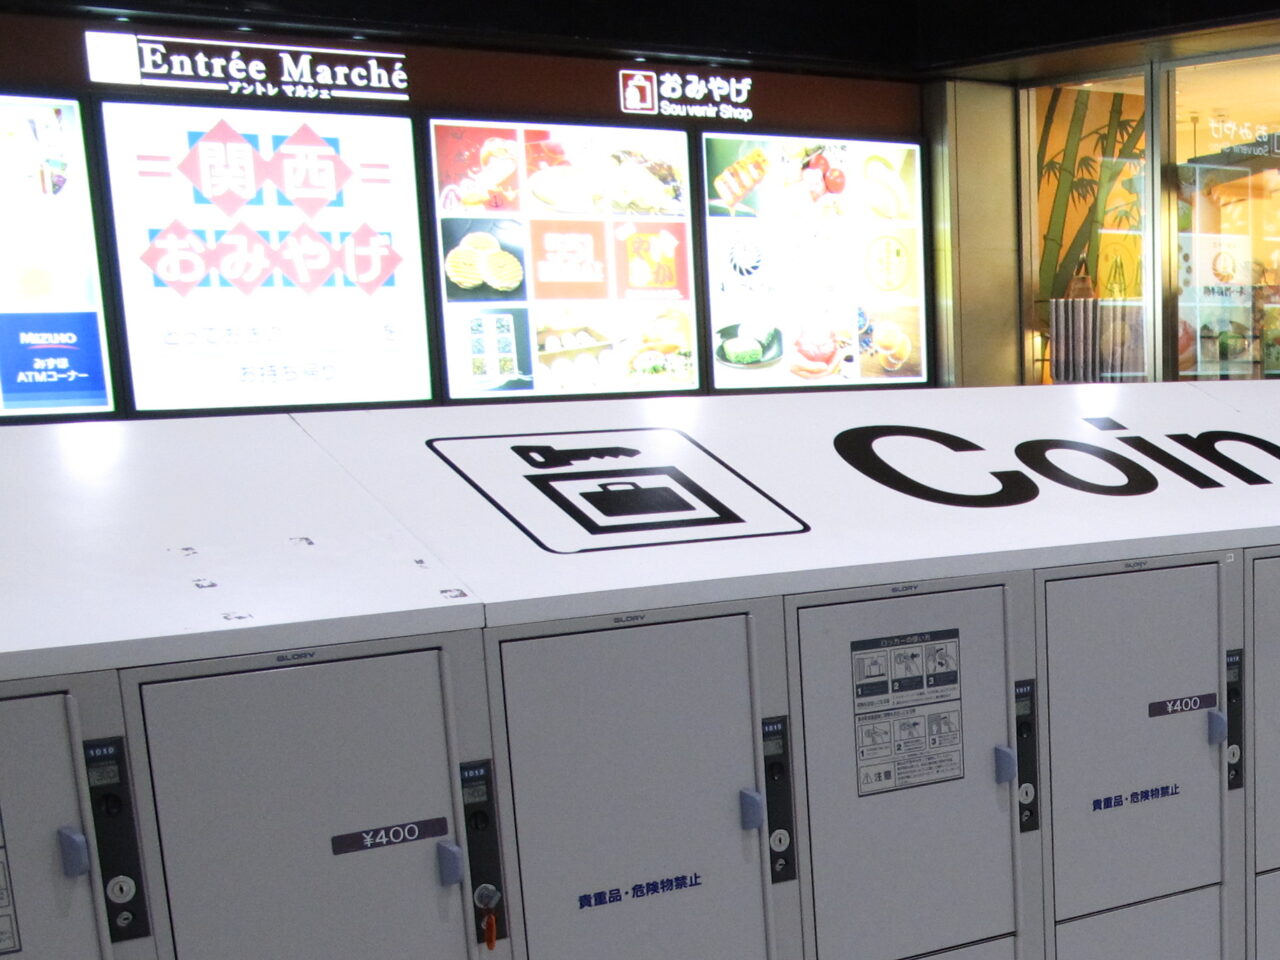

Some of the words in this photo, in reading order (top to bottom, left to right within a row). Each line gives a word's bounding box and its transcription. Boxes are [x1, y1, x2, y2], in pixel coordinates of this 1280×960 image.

[139, 42, 267, 80] Entrée
[280, 53, 409, 89] Marché
[228, 81, 279, 96] アントレ
[282, 84, 331, 99] マルシェ
[659, 72, 753, 103] おみやげ
[719, 103, 753, 122] Shop
[202, 141, 336, 200] 関西
[153, 232, 392, 284] おみやげ
[20, 332, 78, 344] MIZUHO
[17, 370, 89, 383] ATMコーナー
[892, 585, 918, 593] GLORY
[614, 615, 645, 623] GLORY
[277, 652, 316, 662] GLORY
[1166, 696, 1200, 713] ¥400
[90, 747, 115, 756] 1010
[464, 769, 484, 778] 1013
[1092, 784, 1180, 812] 貴重品・危険物禁止
[362, 824, 419, 847] ¥400
[578, 872, 702, 910] 貴重品・危険物禁止
